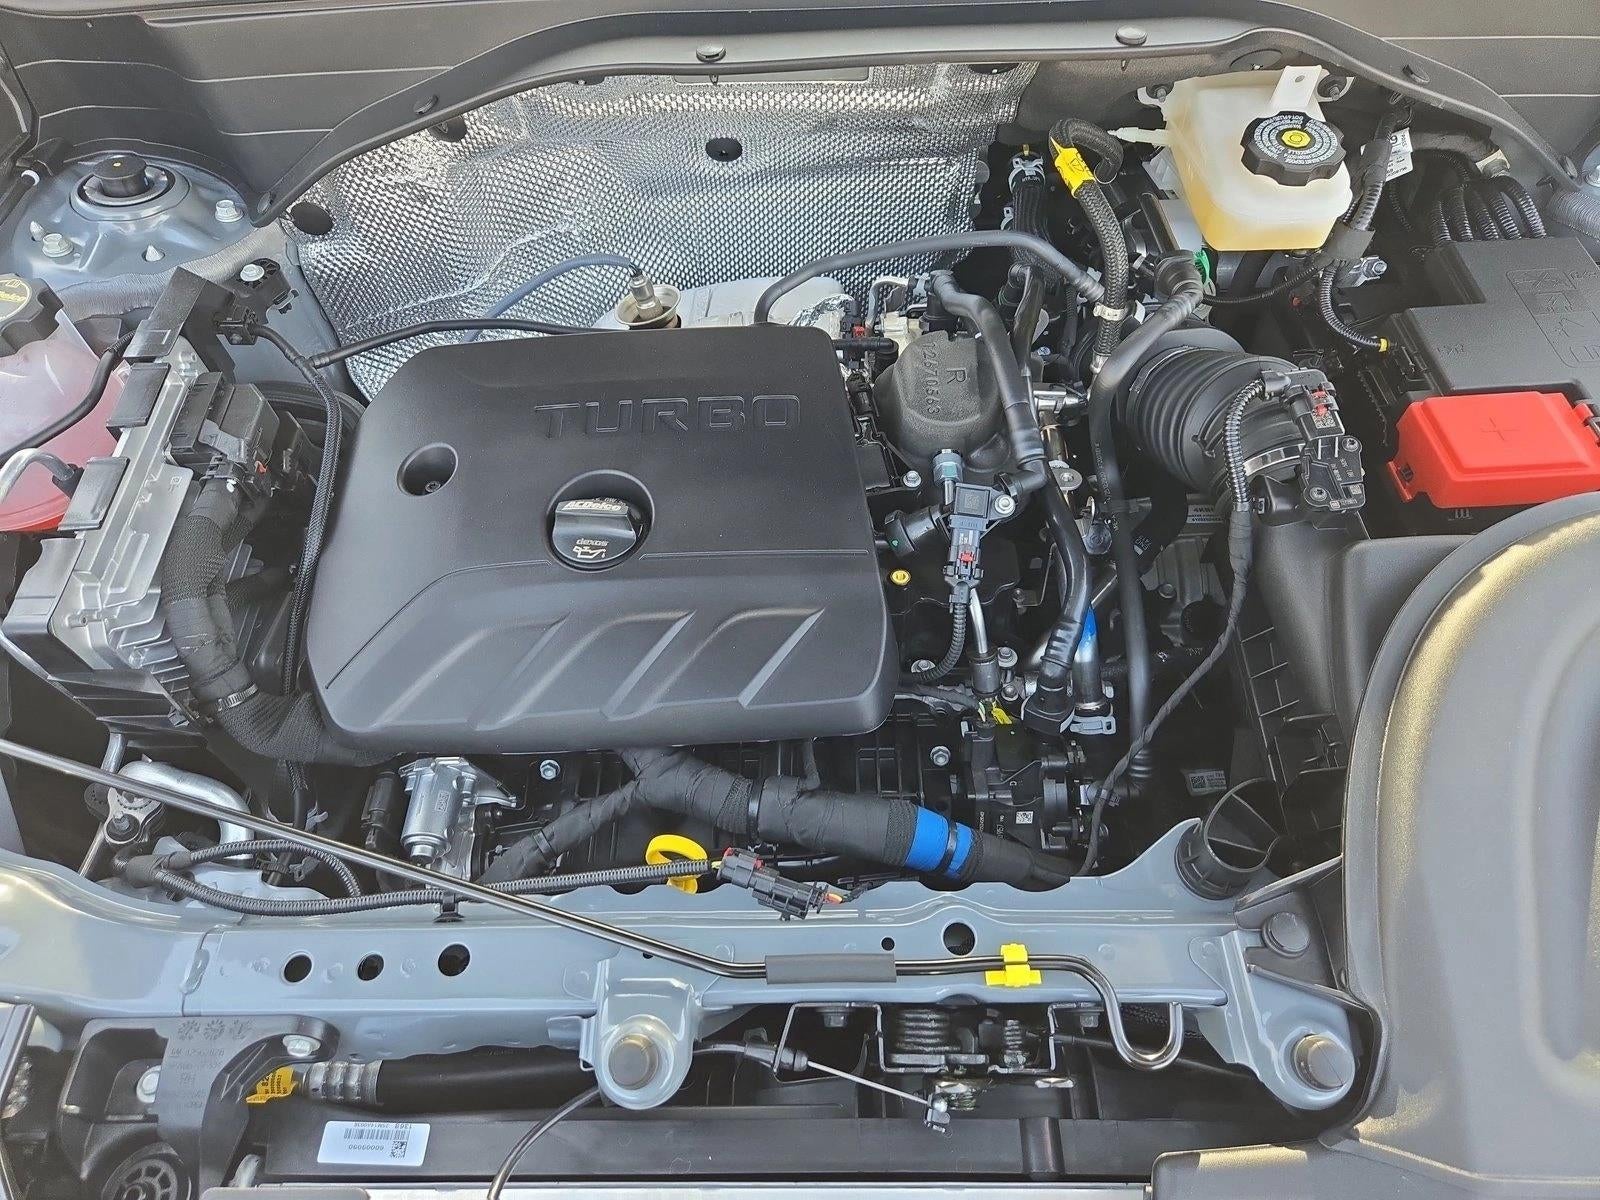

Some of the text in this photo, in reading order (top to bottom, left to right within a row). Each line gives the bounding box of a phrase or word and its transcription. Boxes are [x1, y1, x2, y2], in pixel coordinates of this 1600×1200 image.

[946, 367, 968, 384] R
[534, 394, 800, 438] TURBO
[562, 501, 622, 511] ACDelco
